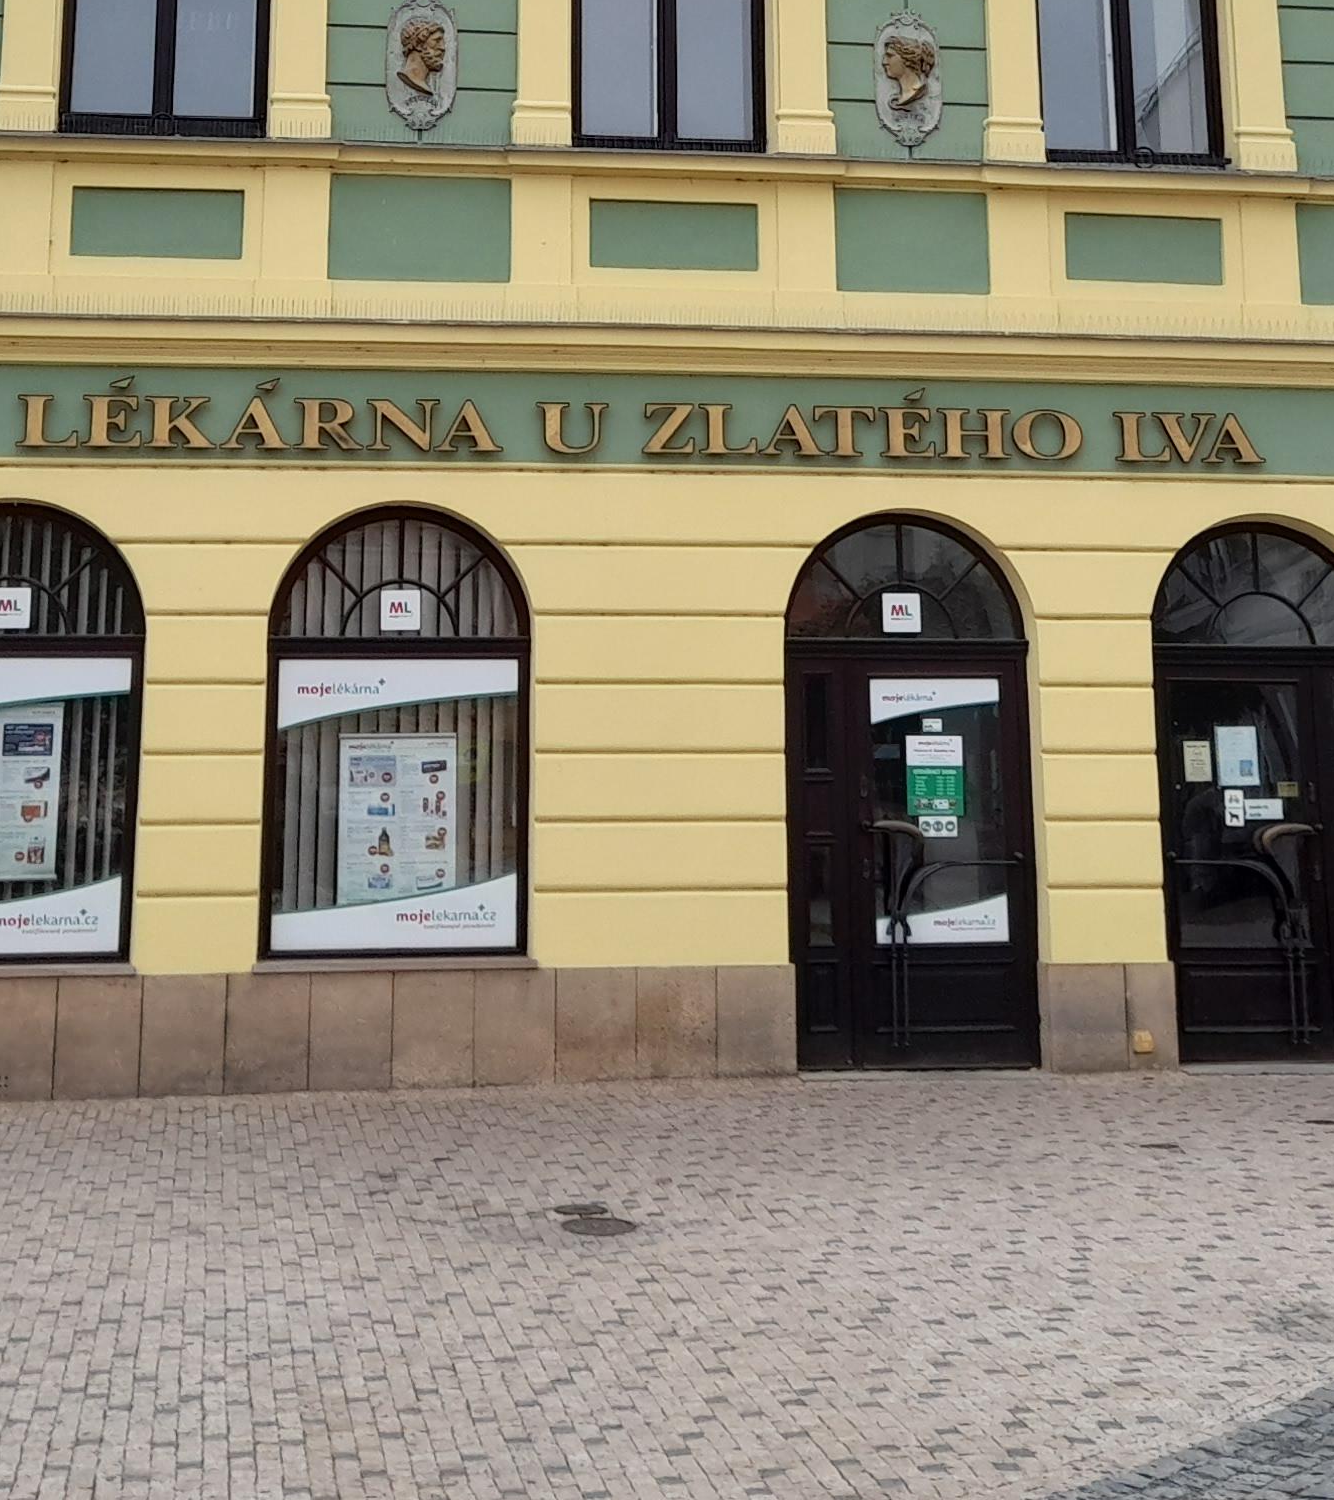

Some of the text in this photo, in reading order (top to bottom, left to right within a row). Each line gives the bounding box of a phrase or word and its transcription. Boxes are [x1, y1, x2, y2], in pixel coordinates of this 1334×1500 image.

[16, 375, 1267, 464] LÉKÁRNA U ZLATÉHO LVA
[389, 602, 412, 614] ML
[890, 604, 913, 617] ML
[297, 682, 380, 697] mojelékárna
[396, 909, 497, 924] mojelekarna.cz
